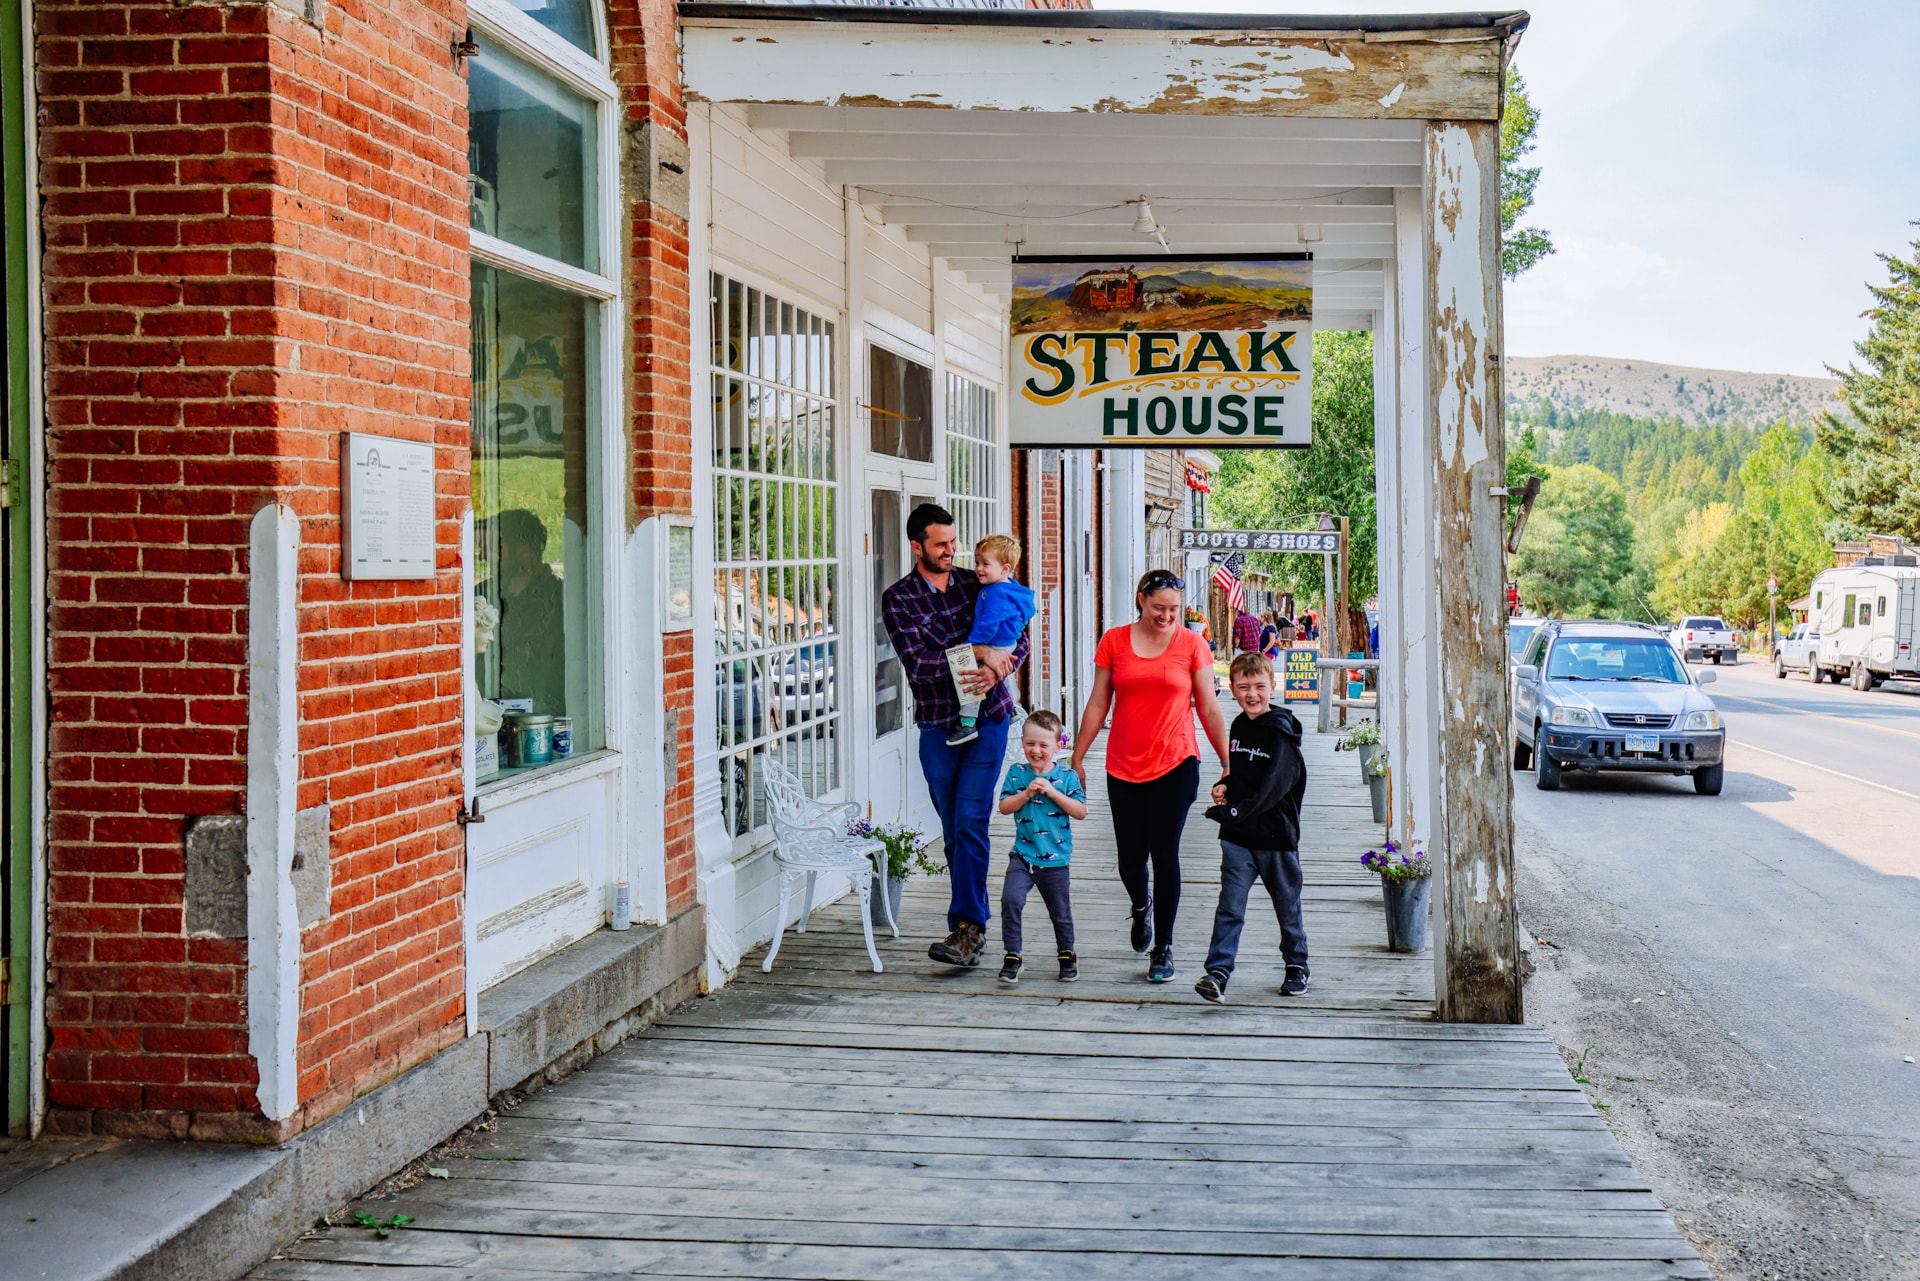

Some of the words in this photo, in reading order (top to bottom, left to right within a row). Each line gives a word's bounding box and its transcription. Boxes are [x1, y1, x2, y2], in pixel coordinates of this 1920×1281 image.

[1023, 331, 1301, 399] STEAK
[1103, 394, 1284, 436] HOUSE
[1182, 532, 1249, 548] BOOTS
[1268, 534, 1336, 549] SHOES
[1291, 652, 1312, 662] OLD
[1288, 662, 1316, 672] TIME
[1285, 671, 1318, 680] FAMILY
[1286, 690, 1318, 699] PHOTOS
[1230, 739, 1270, 761] Champion
